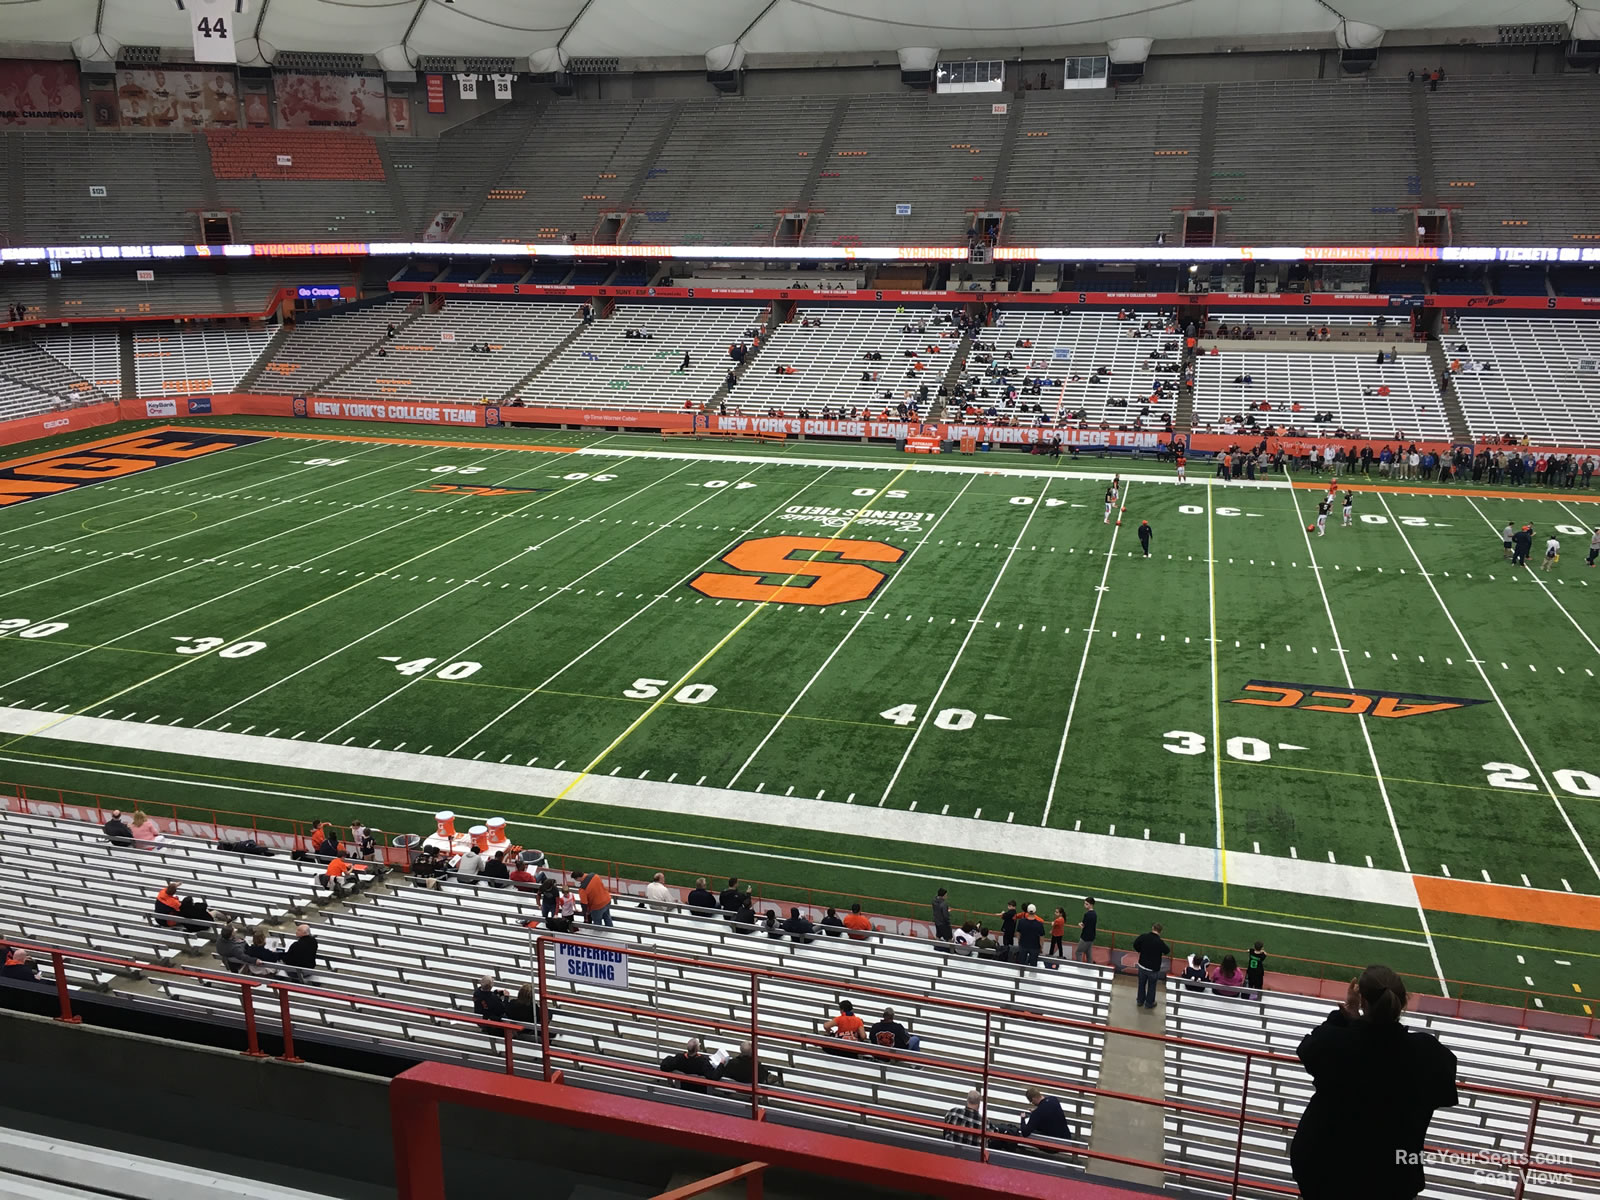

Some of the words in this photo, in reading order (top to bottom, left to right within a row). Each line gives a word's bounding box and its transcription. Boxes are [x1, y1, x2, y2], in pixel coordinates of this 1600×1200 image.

[197, 16, 228, 39] 44
[462, 84, 474, 92] 88
[498, 84, 508, 92] 39
[46, 247, 101, 259] TICKETS
[120, 246, 152, 258] SALE
[254, 244, 312, 256] SYRACUSE
[314, 243, 367, 255] FOOTBALL
[573, 245, 622, 256] SYRACUSE
[626, 246, 672, 257] FOOTBALL
[898, 247, 954, 259] SYRACUSE
[1304, 248, 1371, 260] SYRACUSE
[1374, 248, 1440, 260] FOOTBALL
[1498, 248, 1558, 260] TICKETS
[298, 288, 311, 296] Go
[312, 288, 340, 296] Orange
[688, 288, 694, 298] S
[876, 291, 882, 300] S
[1078, 294, 1086, 303] S
[1304, 295, 1311, 304] S
[1548, 298, 1556, 308] S
[314, 402, 340, 416] NEW
[342, 403, 386, 418] YORK'S
[388, 405, 440, 421] COLLEGE
[442, 408, 476, 423] TEAM
[486, 408, 500, 426] S
[44, 418, 70, 429] GEICO
[718, 416, 748, 430] NEW
[751, 418, 801, 434] YORK'S
[804, 420, 867, 436] COLLEGE
[869, 422, 908, 438] TEAM
[948, 426, 980, 442] NEW
[983, 426, 1038, 443] YORK'S
[1042, 429, 1112, 446] COLLEGE
[1114, 432, 1158, 446] TEAM
[304, 458, 350, 466] 10
[430, 466, 488, 474] 20
[562, 472, 618, 482] 30
[702, 480, 758, 490] 40
[852, 487, 910, 499] 50
[1008, 496, 1068, 508] 40
[785, 505, 842, 515] FIELD
[842, 508, 935, 522] LEGENDS
[1178, 504, 1242, 516] 30
[1359, 514, 1431, 527] 20
[686, 534, 908, 606] S
[0, 618, 70, 638] 20
[176, 636, 268, 658] 30
[396, 656, 482, 680] 40
[622, 678, 718, 704] 50
[1230, 684, 1464, 718] ACC
[879, 704, 978, 731] 40
[1162, 730, 1272, 762] 30
[1481, 762, 1600, 798] 20
[560, 942, 622, 963] PREFERRED
[568, 958, 614, 980] SEATING
